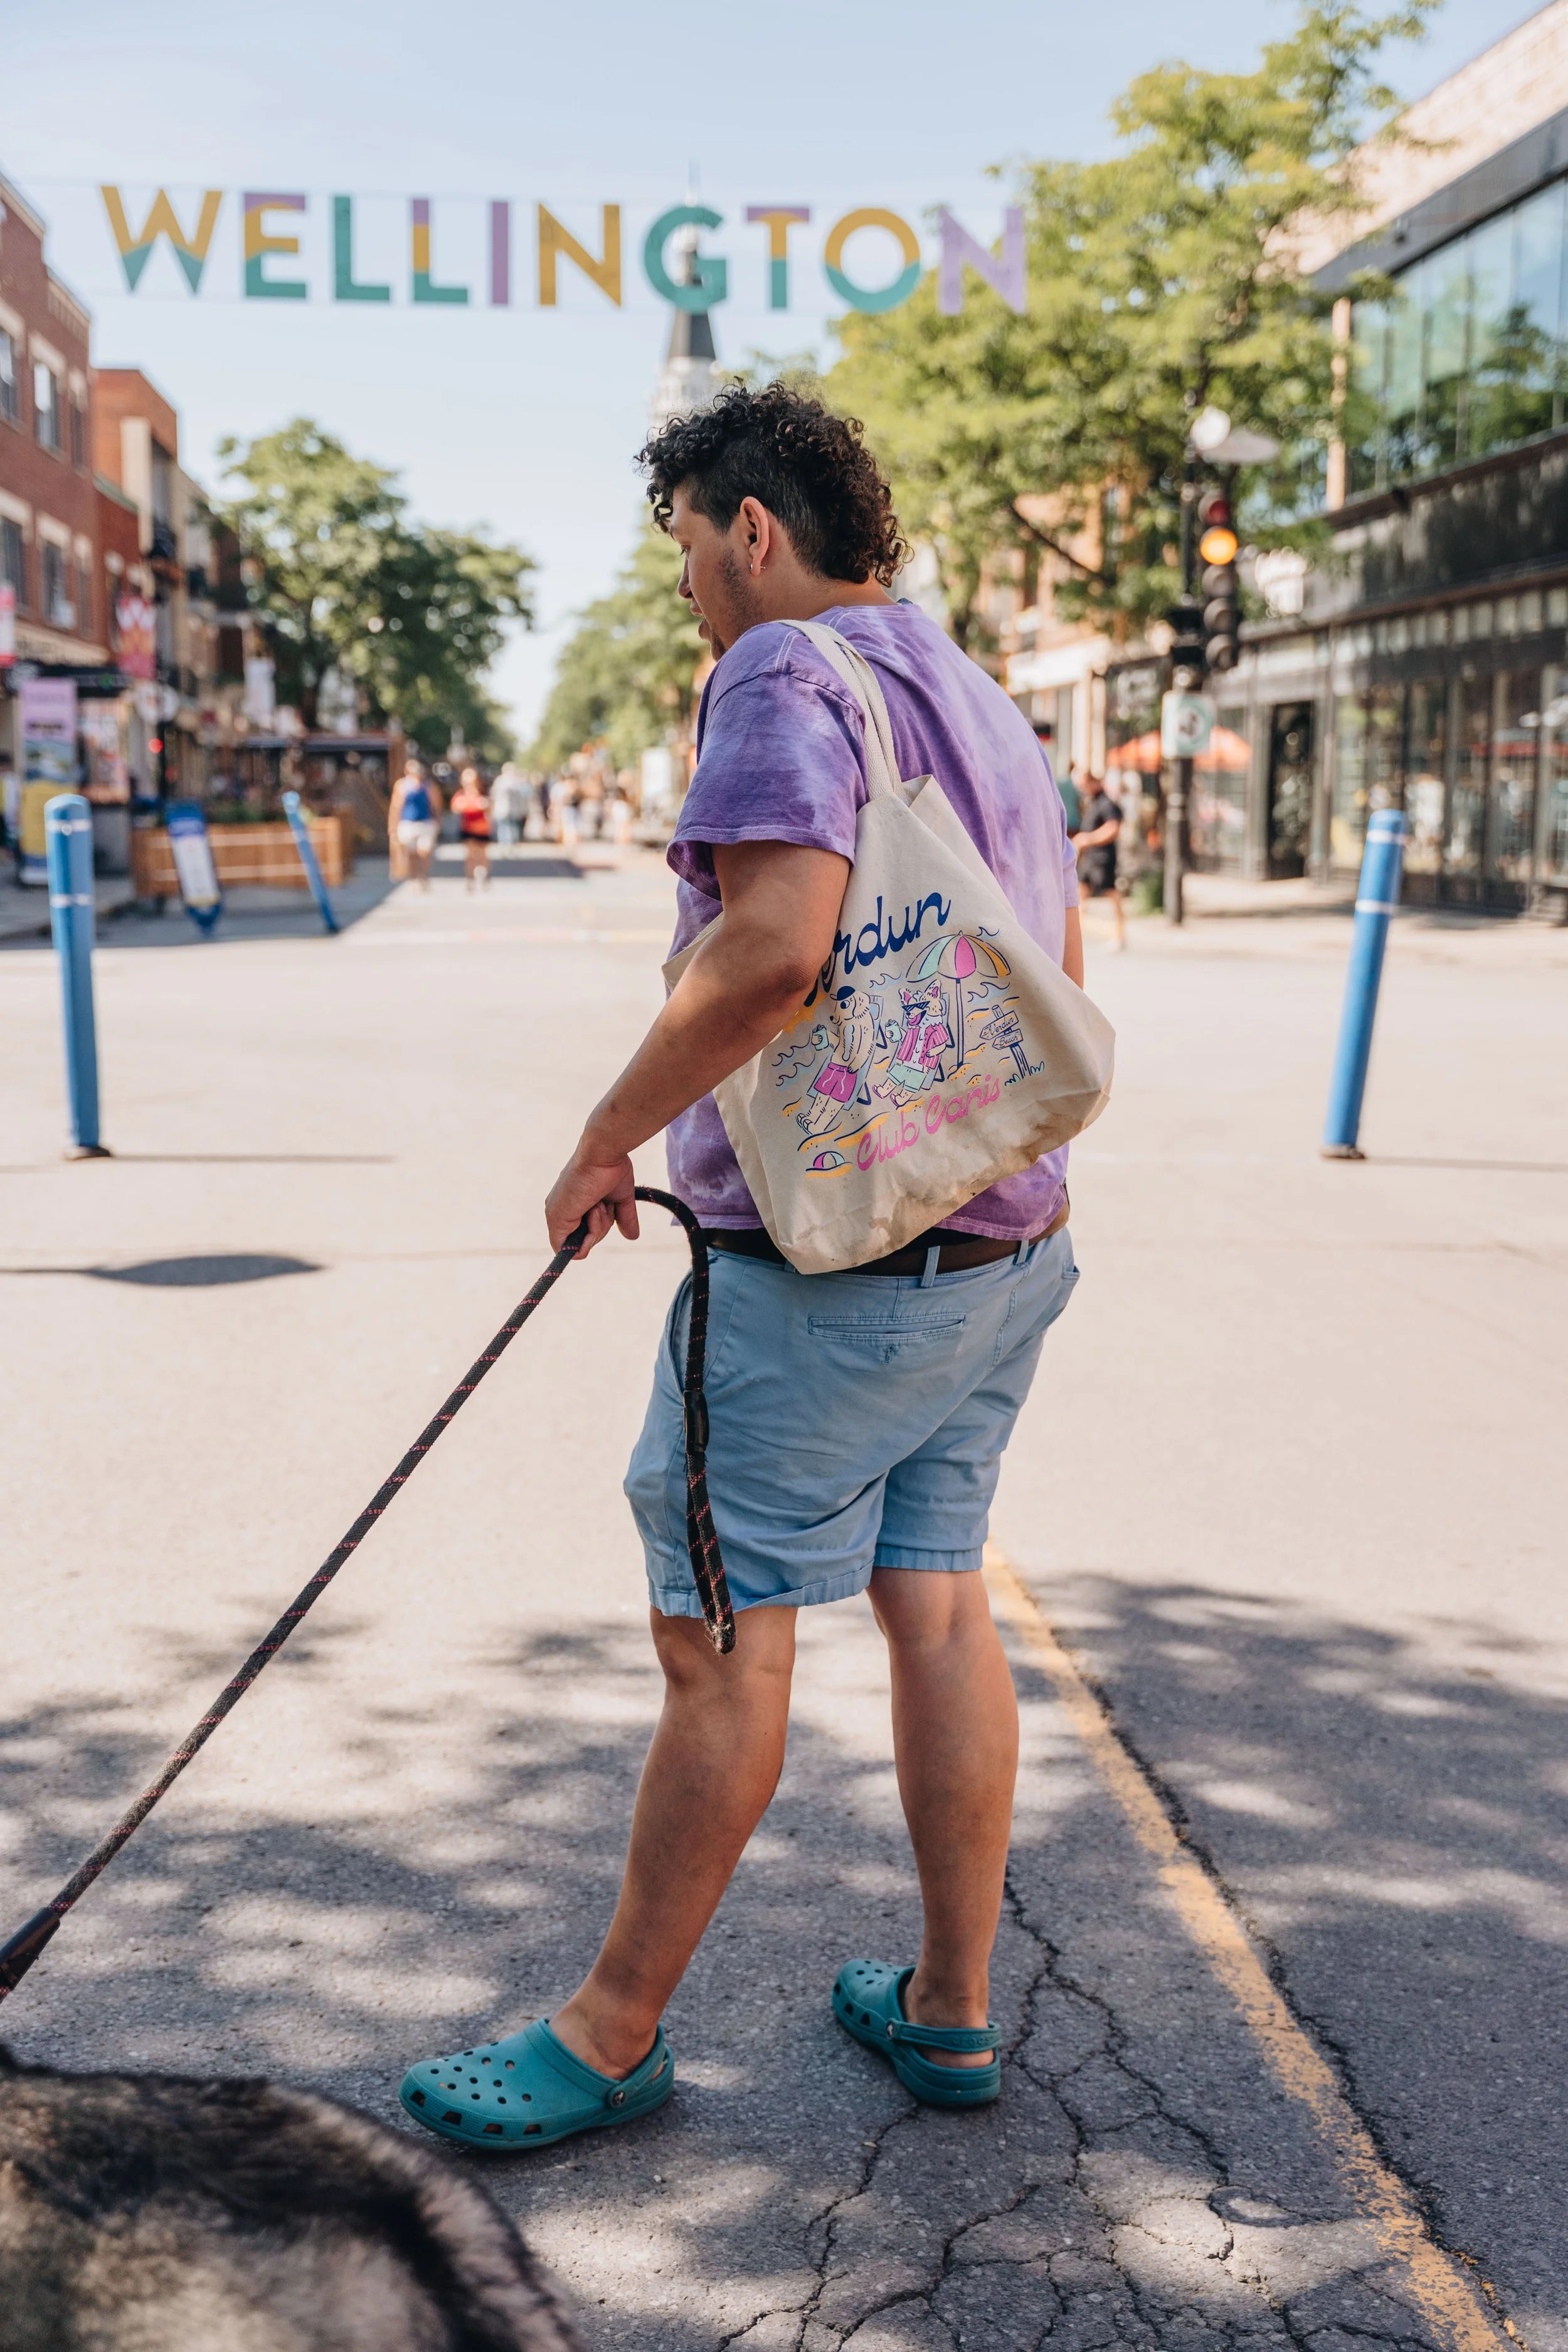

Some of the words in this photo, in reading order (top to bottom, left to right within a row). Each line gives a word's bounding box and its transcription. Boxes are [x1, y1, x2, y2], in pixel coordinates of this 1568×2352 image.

[100, 185, 1024, 313] WELLINGTON
[803, 892, 951, 1008] erdun
[988, 1016, 1014, 1035] Verdun
[999, 1032, 1018, 1046] Beach
[857, 1110, 920, 1171] Club
[925, 1074, 1000, 1134] Canis
